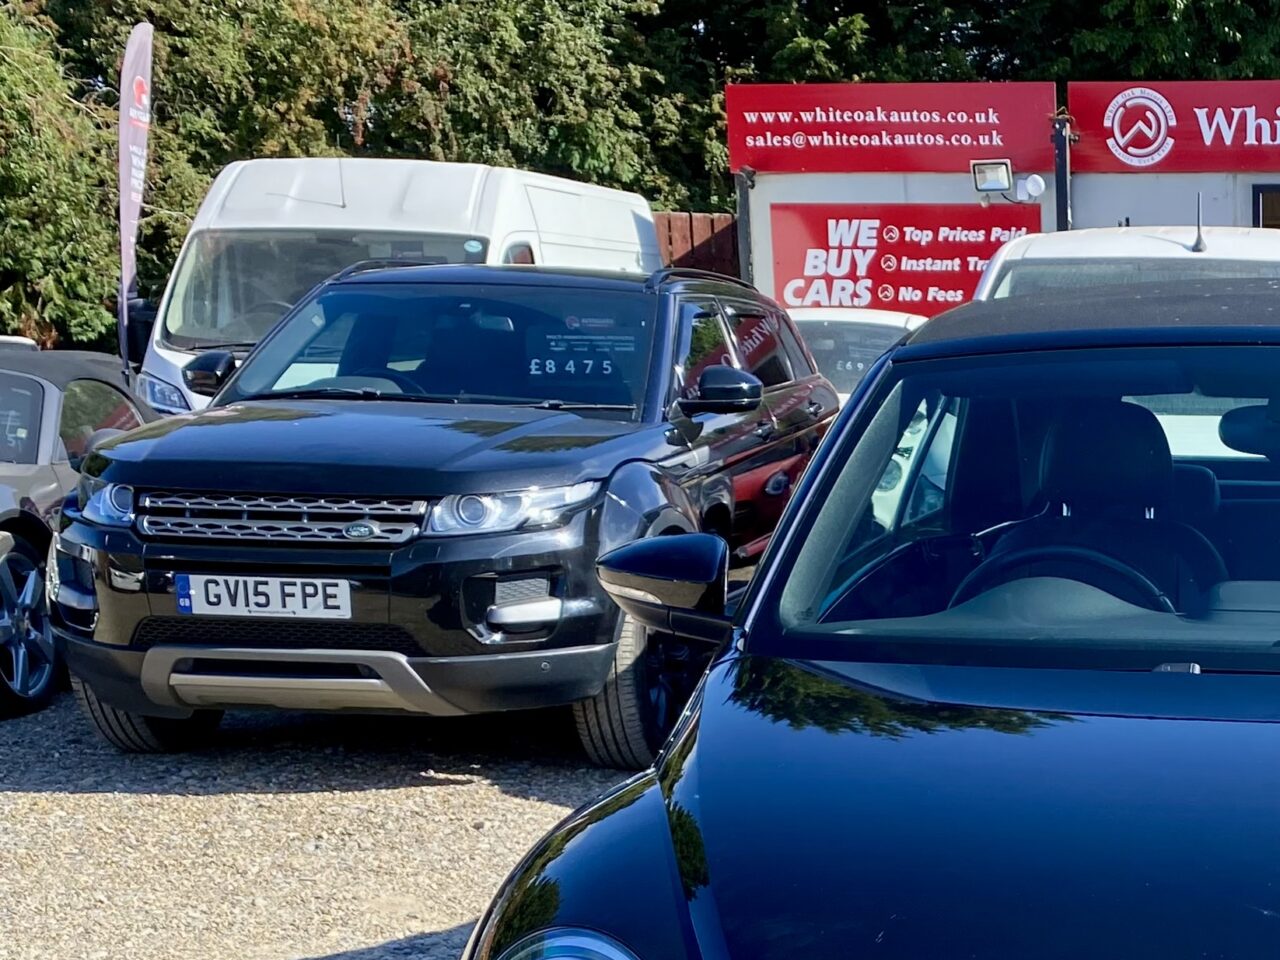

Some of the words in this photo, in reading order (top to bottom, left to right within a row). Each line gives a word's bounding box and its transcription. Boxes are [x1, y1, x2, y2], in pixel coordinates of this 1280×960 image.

[743, 106, 1000, 123] www.whiteoakautos.co.uk
[745, 130, 1003, 149] sales@whiteoakautos.co.uk
[827, 219, 880, 247] WE
[903, 226, 931, 245] Top
[937, 226, 985, 242] Prices
[990, 226, 1027, 242] Paid
[803, 248, 878, 277] BUY
[900, 256, 961, 271] Instant
[783, 278, 873, 307] CARS
[898, 286, 922, 301] No
[927, 286, 964, 301] Fees
[529, 358, 612, 375] £8475
[179, 597, 190, 607] GB
[203, 578, 270, 608] GV15
[279, 580, 341, 610] FPE
